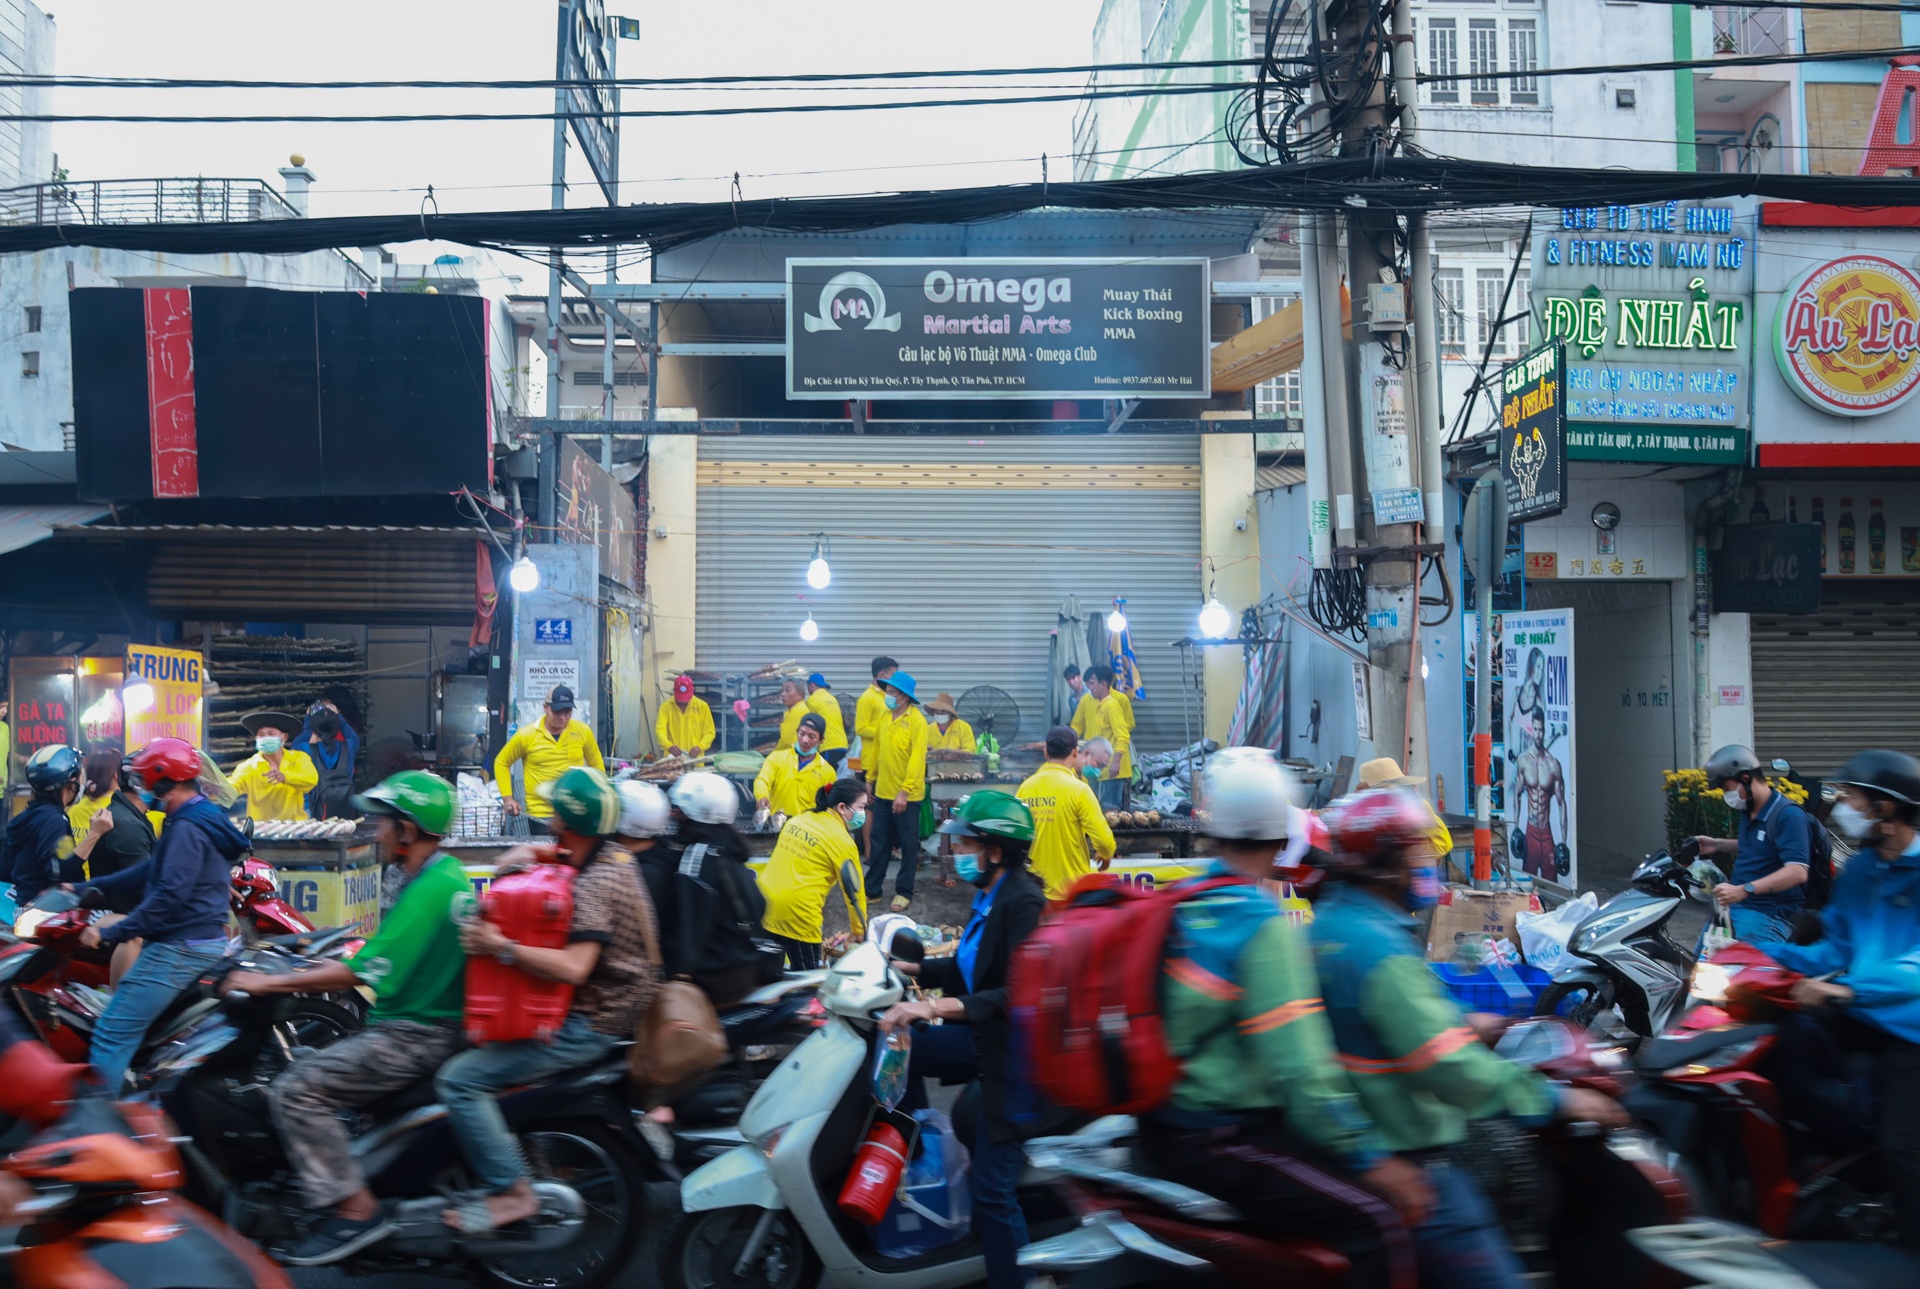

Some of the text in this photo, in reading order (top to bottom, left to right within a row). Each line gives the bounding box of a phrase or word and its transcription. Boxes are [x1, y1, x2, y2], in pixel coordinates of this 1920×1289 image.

[1545, 236, 1746, 270] & FITNESS NAM NỮ
[923, 269, 1073, 313] Omega
[1102, 287, 1173, 303] Muay Thái
[923, 313, 1072, 335] Martial Arts
[1102, 307, 1183, 324] Kick Boxing
[1543, 276, 1744, 360] ĐỆ NHẤT
[1787, 291, 1920, 360] Âu Lạ
[1102, 327, 1136, 340] MMA
[898, 346, 918, 362] Câu
[920, 346, 936, 365] lạc
[938, 346, 951, 365] bộ
[953, 346, 967, 362] Võ
[968, 346, 1000, 365] Thuật
[1001, 348, 1027, 362] MMA
[1035, 347, 1072, 365] Omega
[1074, 346, 1098, 362] Club
[834, 377, 843, 385] 44
[844, 377, 858, 385] Tân
[870, 377, 884, 385] Tân
[951, 376, 960, 386] Q.
[961, 376, 975, 385] Tân
[993, 376, 1005, 385] TP.
[1006, 376, 1026, 385] HCM
[1094, 376, 1122, 385] Hotline:
[1167, 377, 1179, 385] Mr
[1505, 364, 1525, 394] CLB
[1628, 369, 1684, 396] NGOẠI
[1689, 367, 1738, 398] NHẬP
[1529, 554, 1554, 568] 42
[538, 619, 569, 635] 44
[1529, 628, 1556, 646] NHẤT
[131, 652, 200, 683] TRUNG
[1546, 654, 1568, 707] GYM
[18, 699, 65, 721] GÀ TA
[1637, 692, 1647, 707] 10
[785, 823, 819, 847] TRUNG
[343, 872, 377, 906] TRUNG
